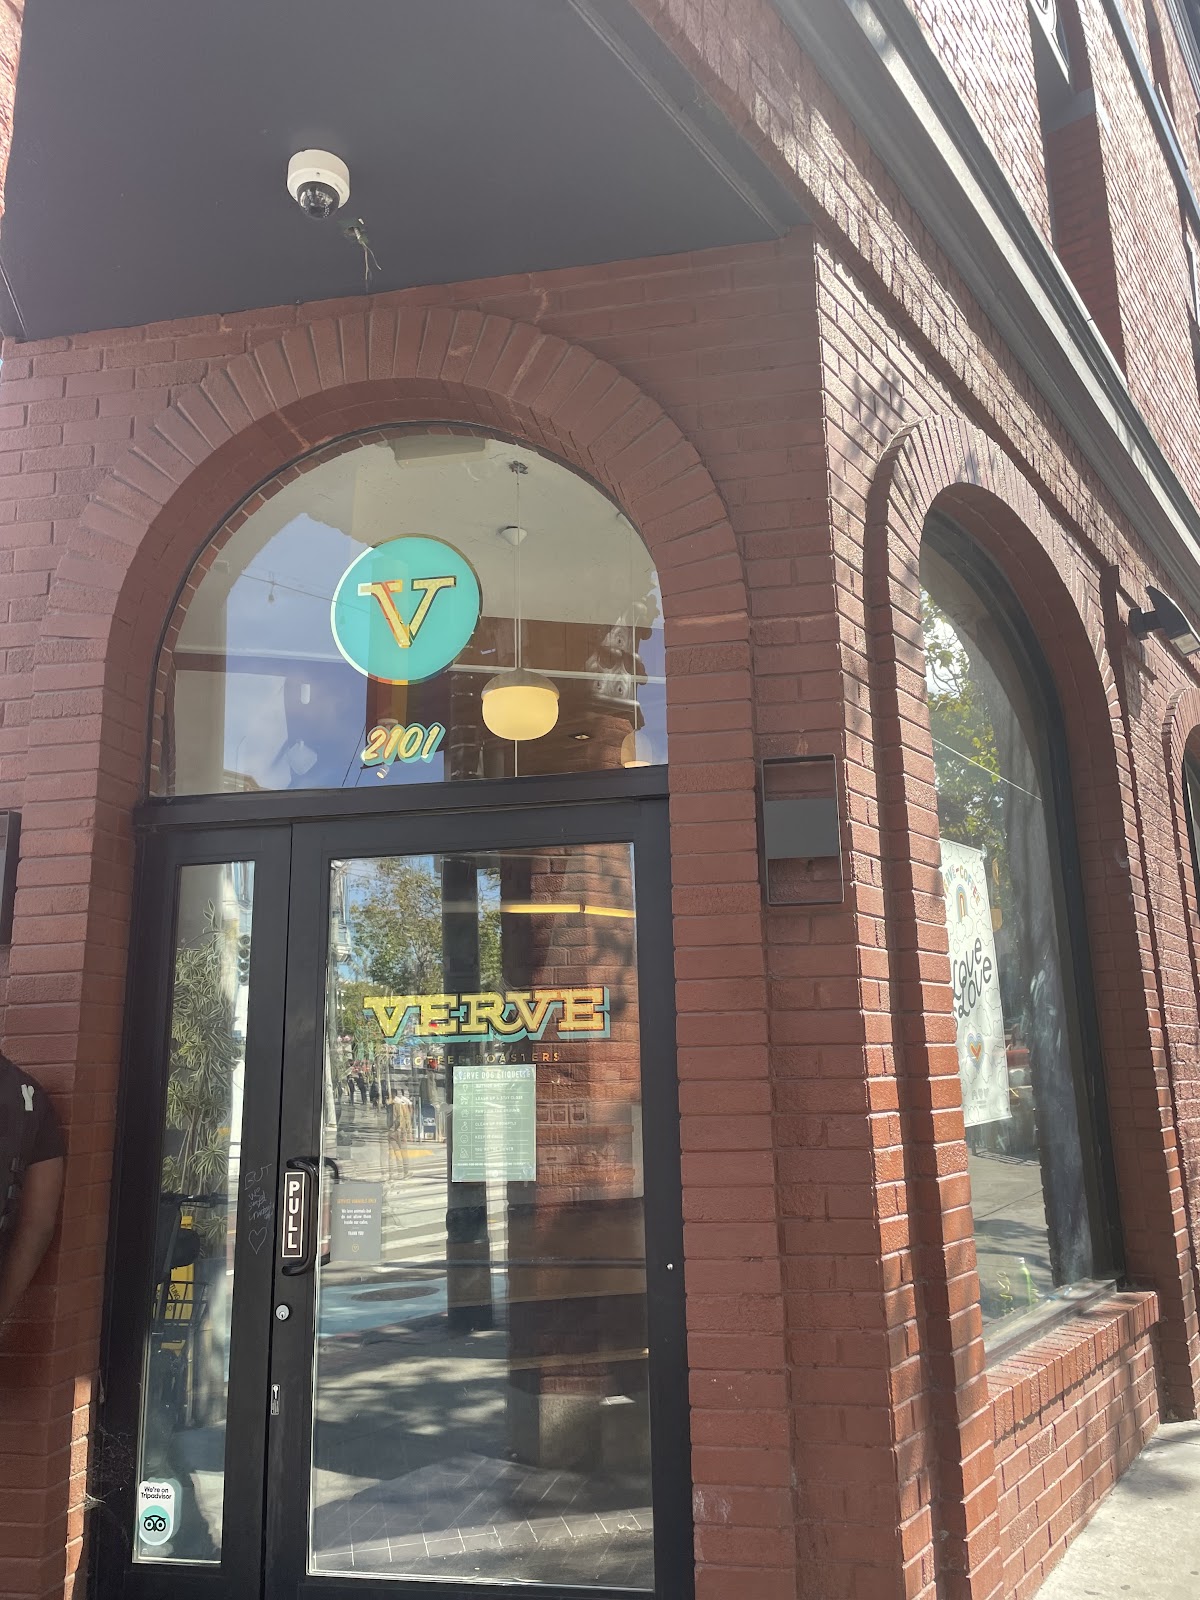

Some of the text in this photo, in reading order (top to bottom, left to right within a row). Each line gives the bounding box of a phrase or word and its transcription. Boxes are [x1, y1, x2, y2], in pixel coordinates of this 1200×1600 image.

[357, 575, 457, 648] V
[360, 721, 446, 764] 2101
[363, 986, 610, 1044] VERVE
[403, 1052, 560, 1066] COFFEE ROASTERS
[481, 1071, 495, 1079] DOG
[287, 1180, 300, 1249] PULL
[141, 1492, 172, 1500] Tripadvisor
[144, 1485, 160, 1493] We're
